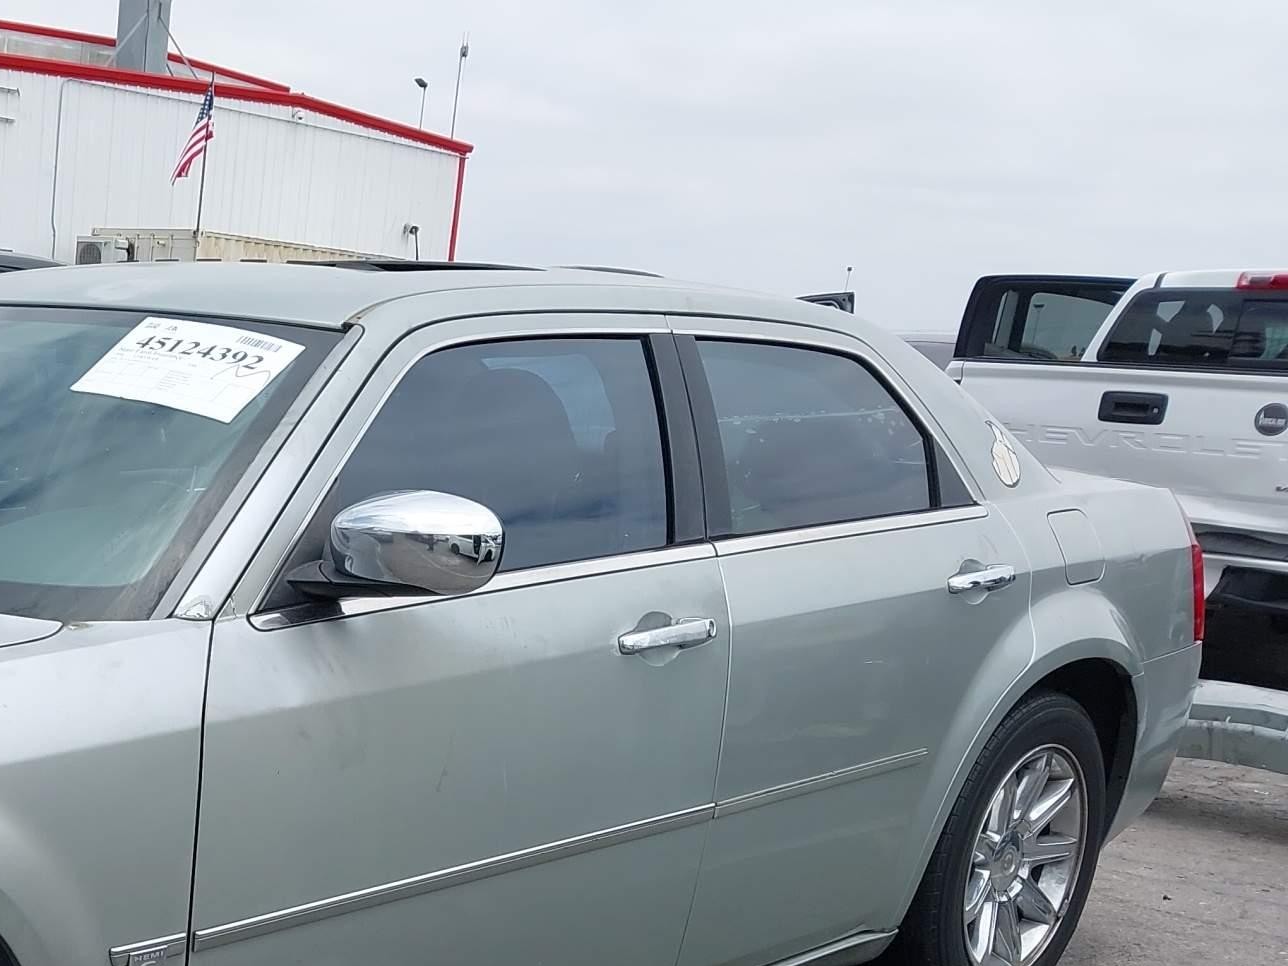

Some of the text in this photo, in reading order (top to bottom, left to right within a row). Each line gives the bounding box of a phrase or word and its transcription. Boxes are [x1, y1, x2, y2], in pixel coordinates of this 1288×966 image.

[136, 335, 264, 370] 45124392
[1000, 422, 1288, 462] HEVROLE
[134, 950, 164, 962] HEMI
